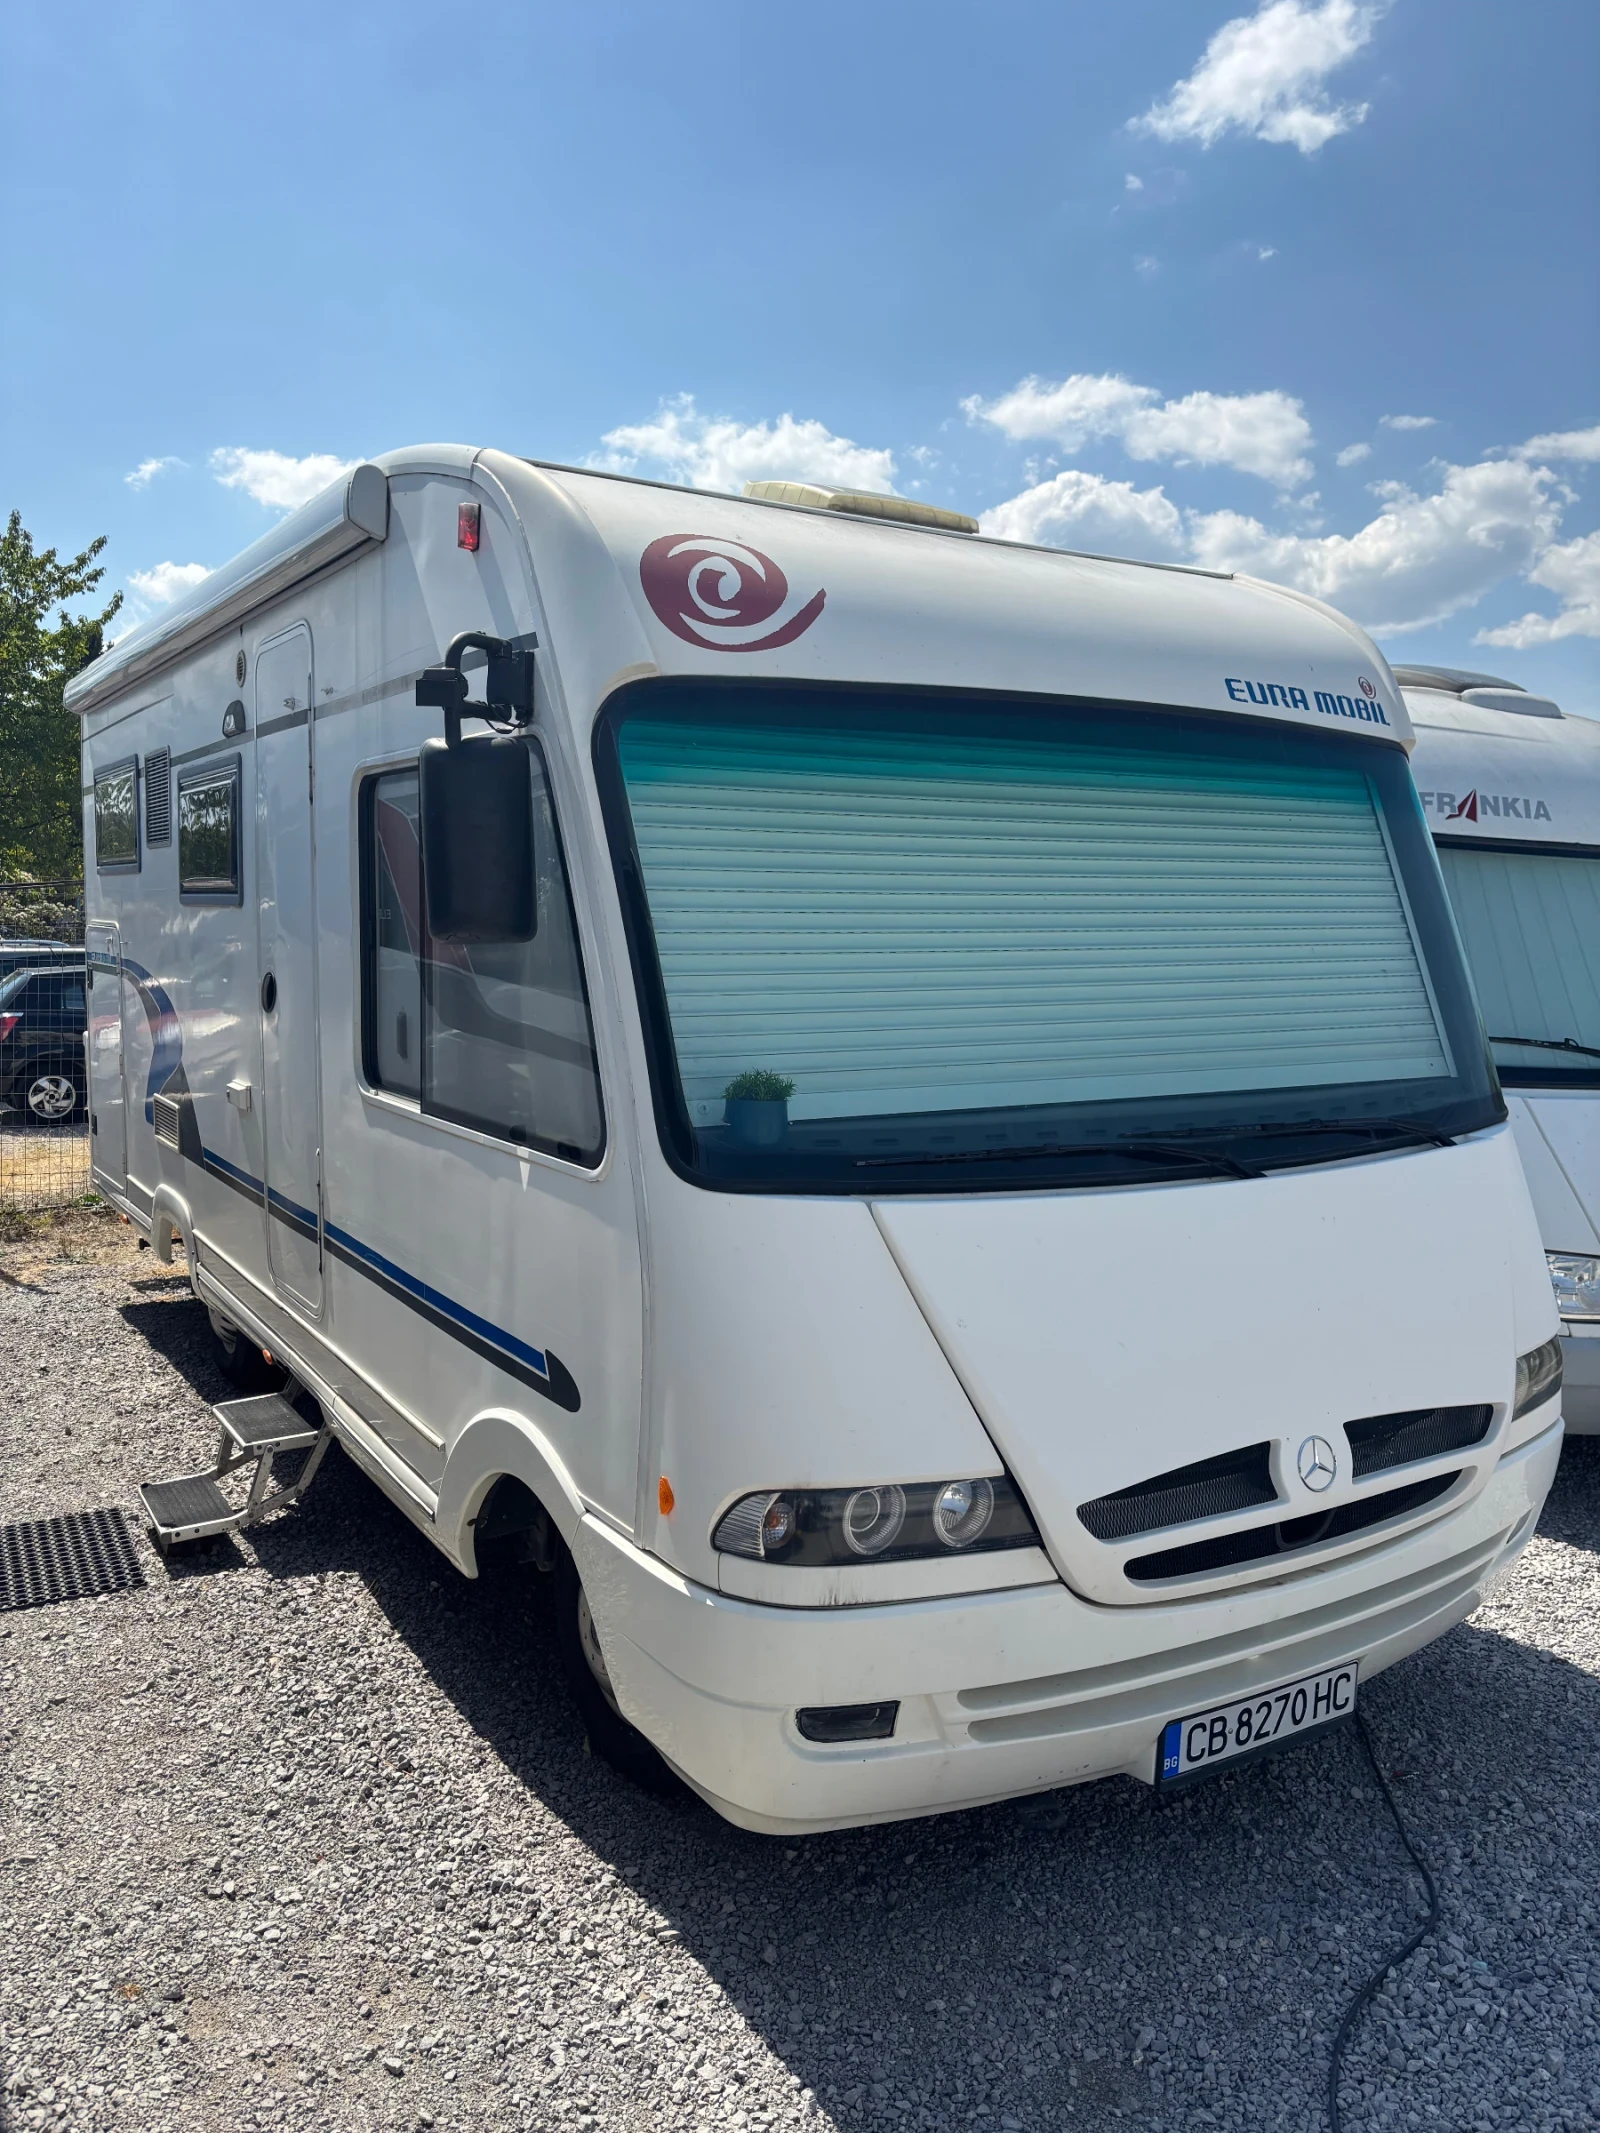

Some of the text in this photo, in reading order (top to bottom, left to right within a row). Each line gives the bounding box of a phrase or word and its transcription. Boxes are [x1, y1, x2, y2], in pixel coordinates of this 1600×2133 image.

[1224, 677, 1391, 727] EURA MOBIL
[1418, 788, 1552, 823] FRANKIA
[1186, 1672, 1351, 1763] CB 8270 HC
[1163, 1756, 1178, 1771] BG
